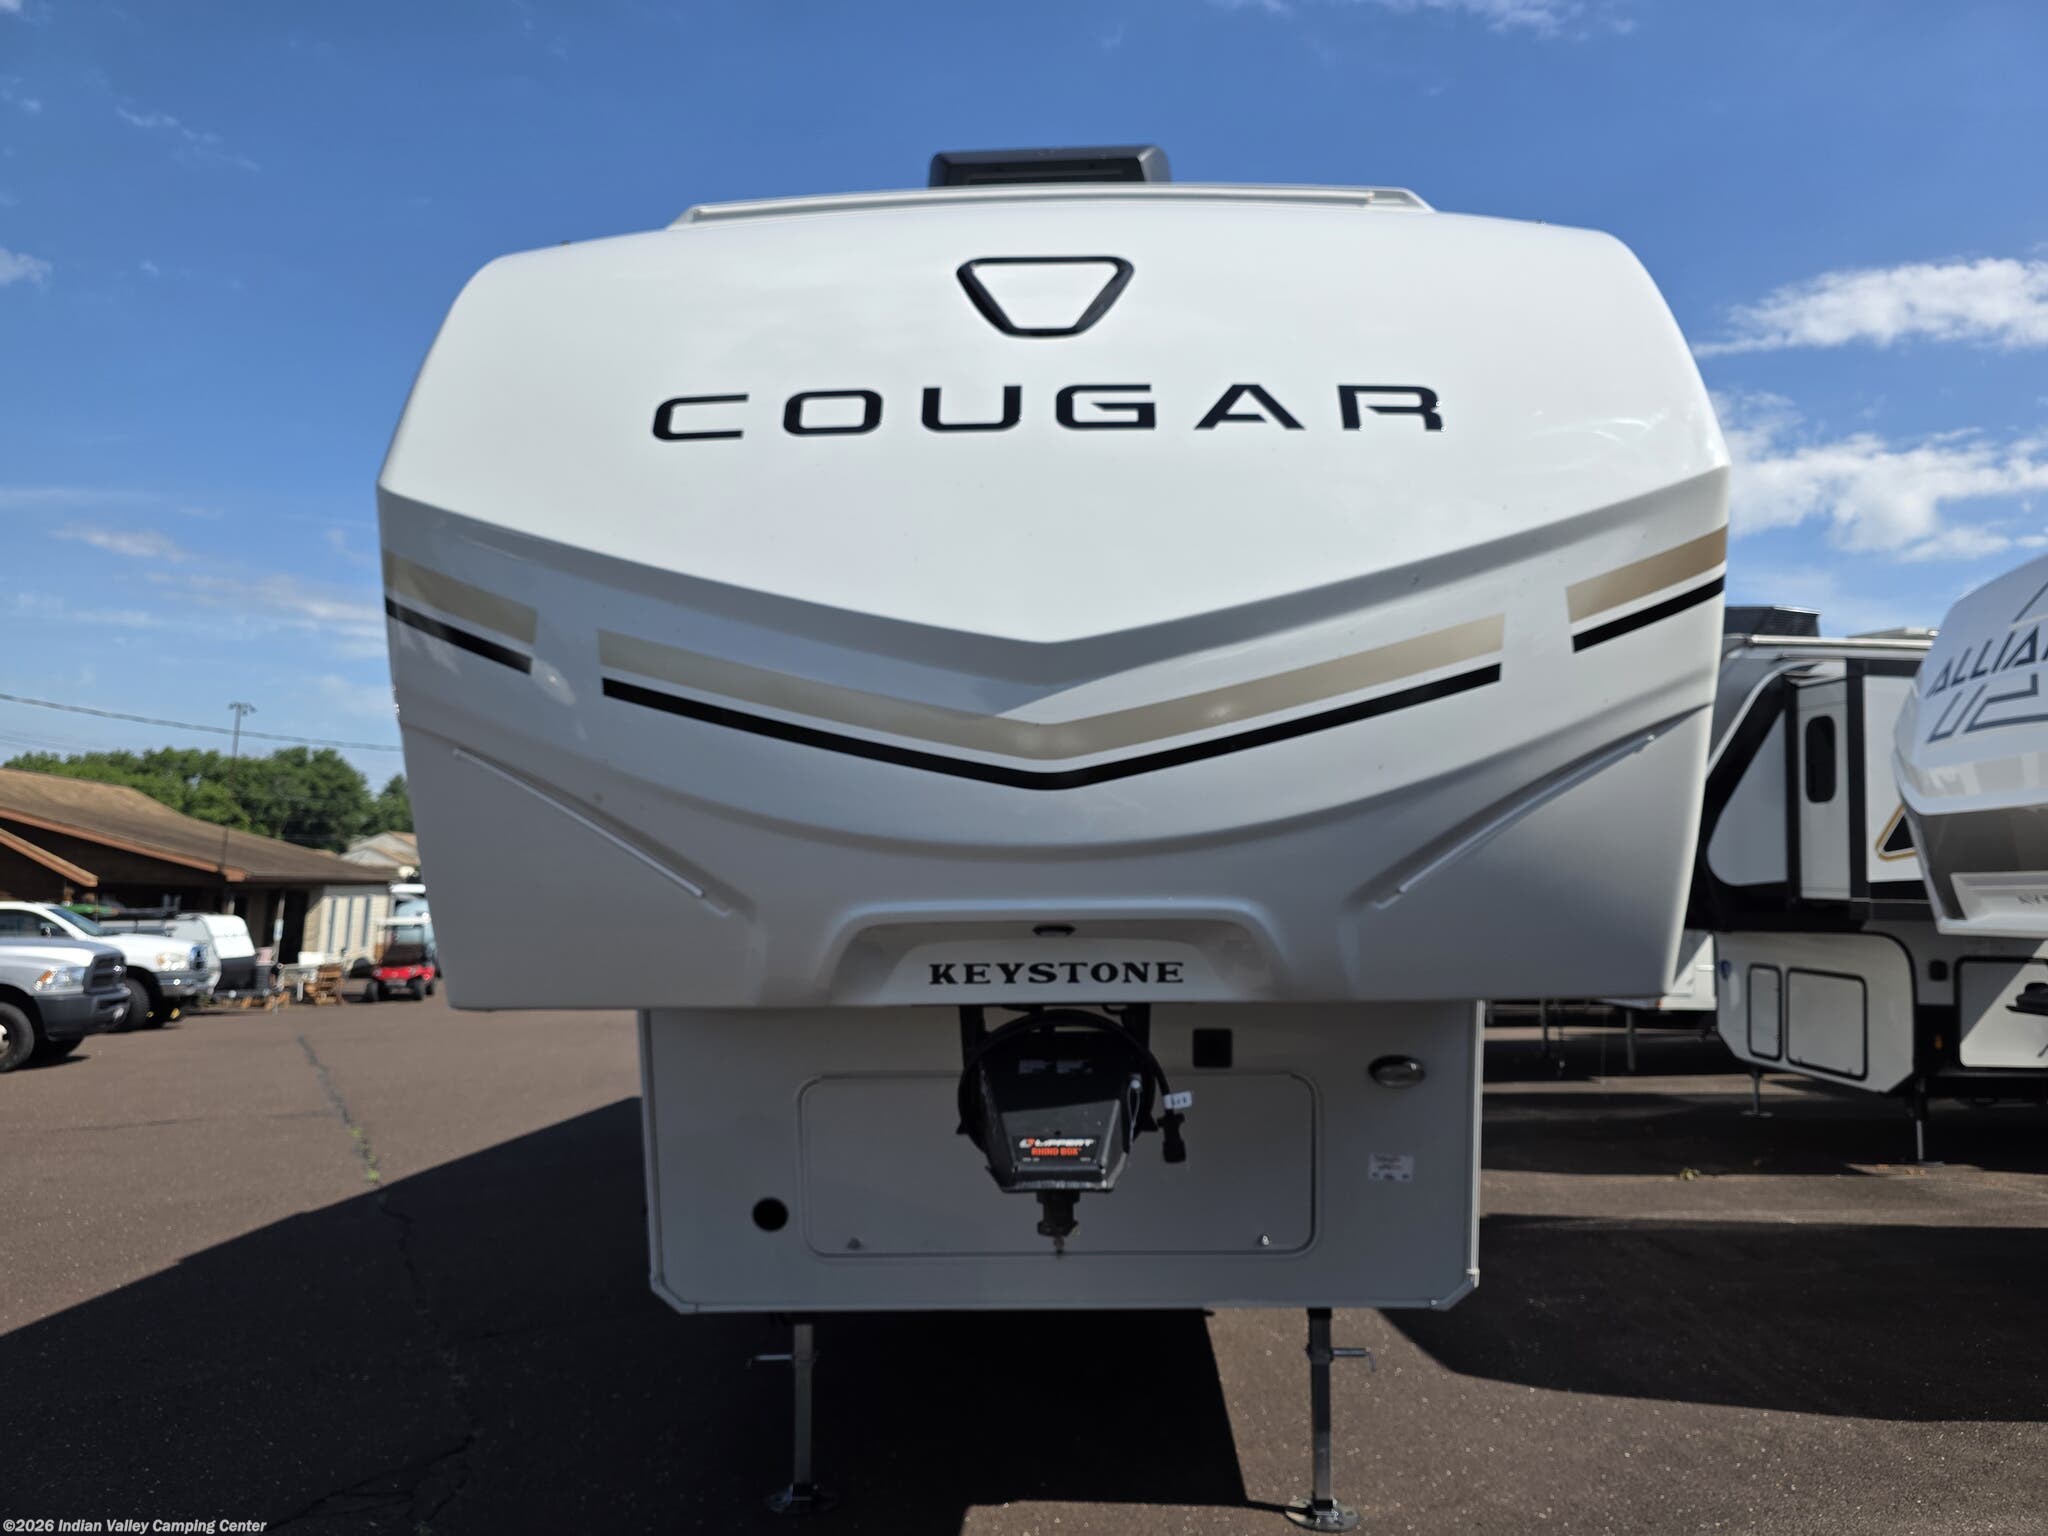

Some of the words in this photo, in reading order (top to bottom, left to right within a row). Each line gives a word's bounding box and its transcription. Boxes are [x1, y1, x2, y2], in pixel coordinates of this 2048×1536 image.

[653, 383, 1444, 441] COUGAR
[929, 962, 1184, 985] KEYSTONE
[1031, 1147, 1059, 1156] RHINO
